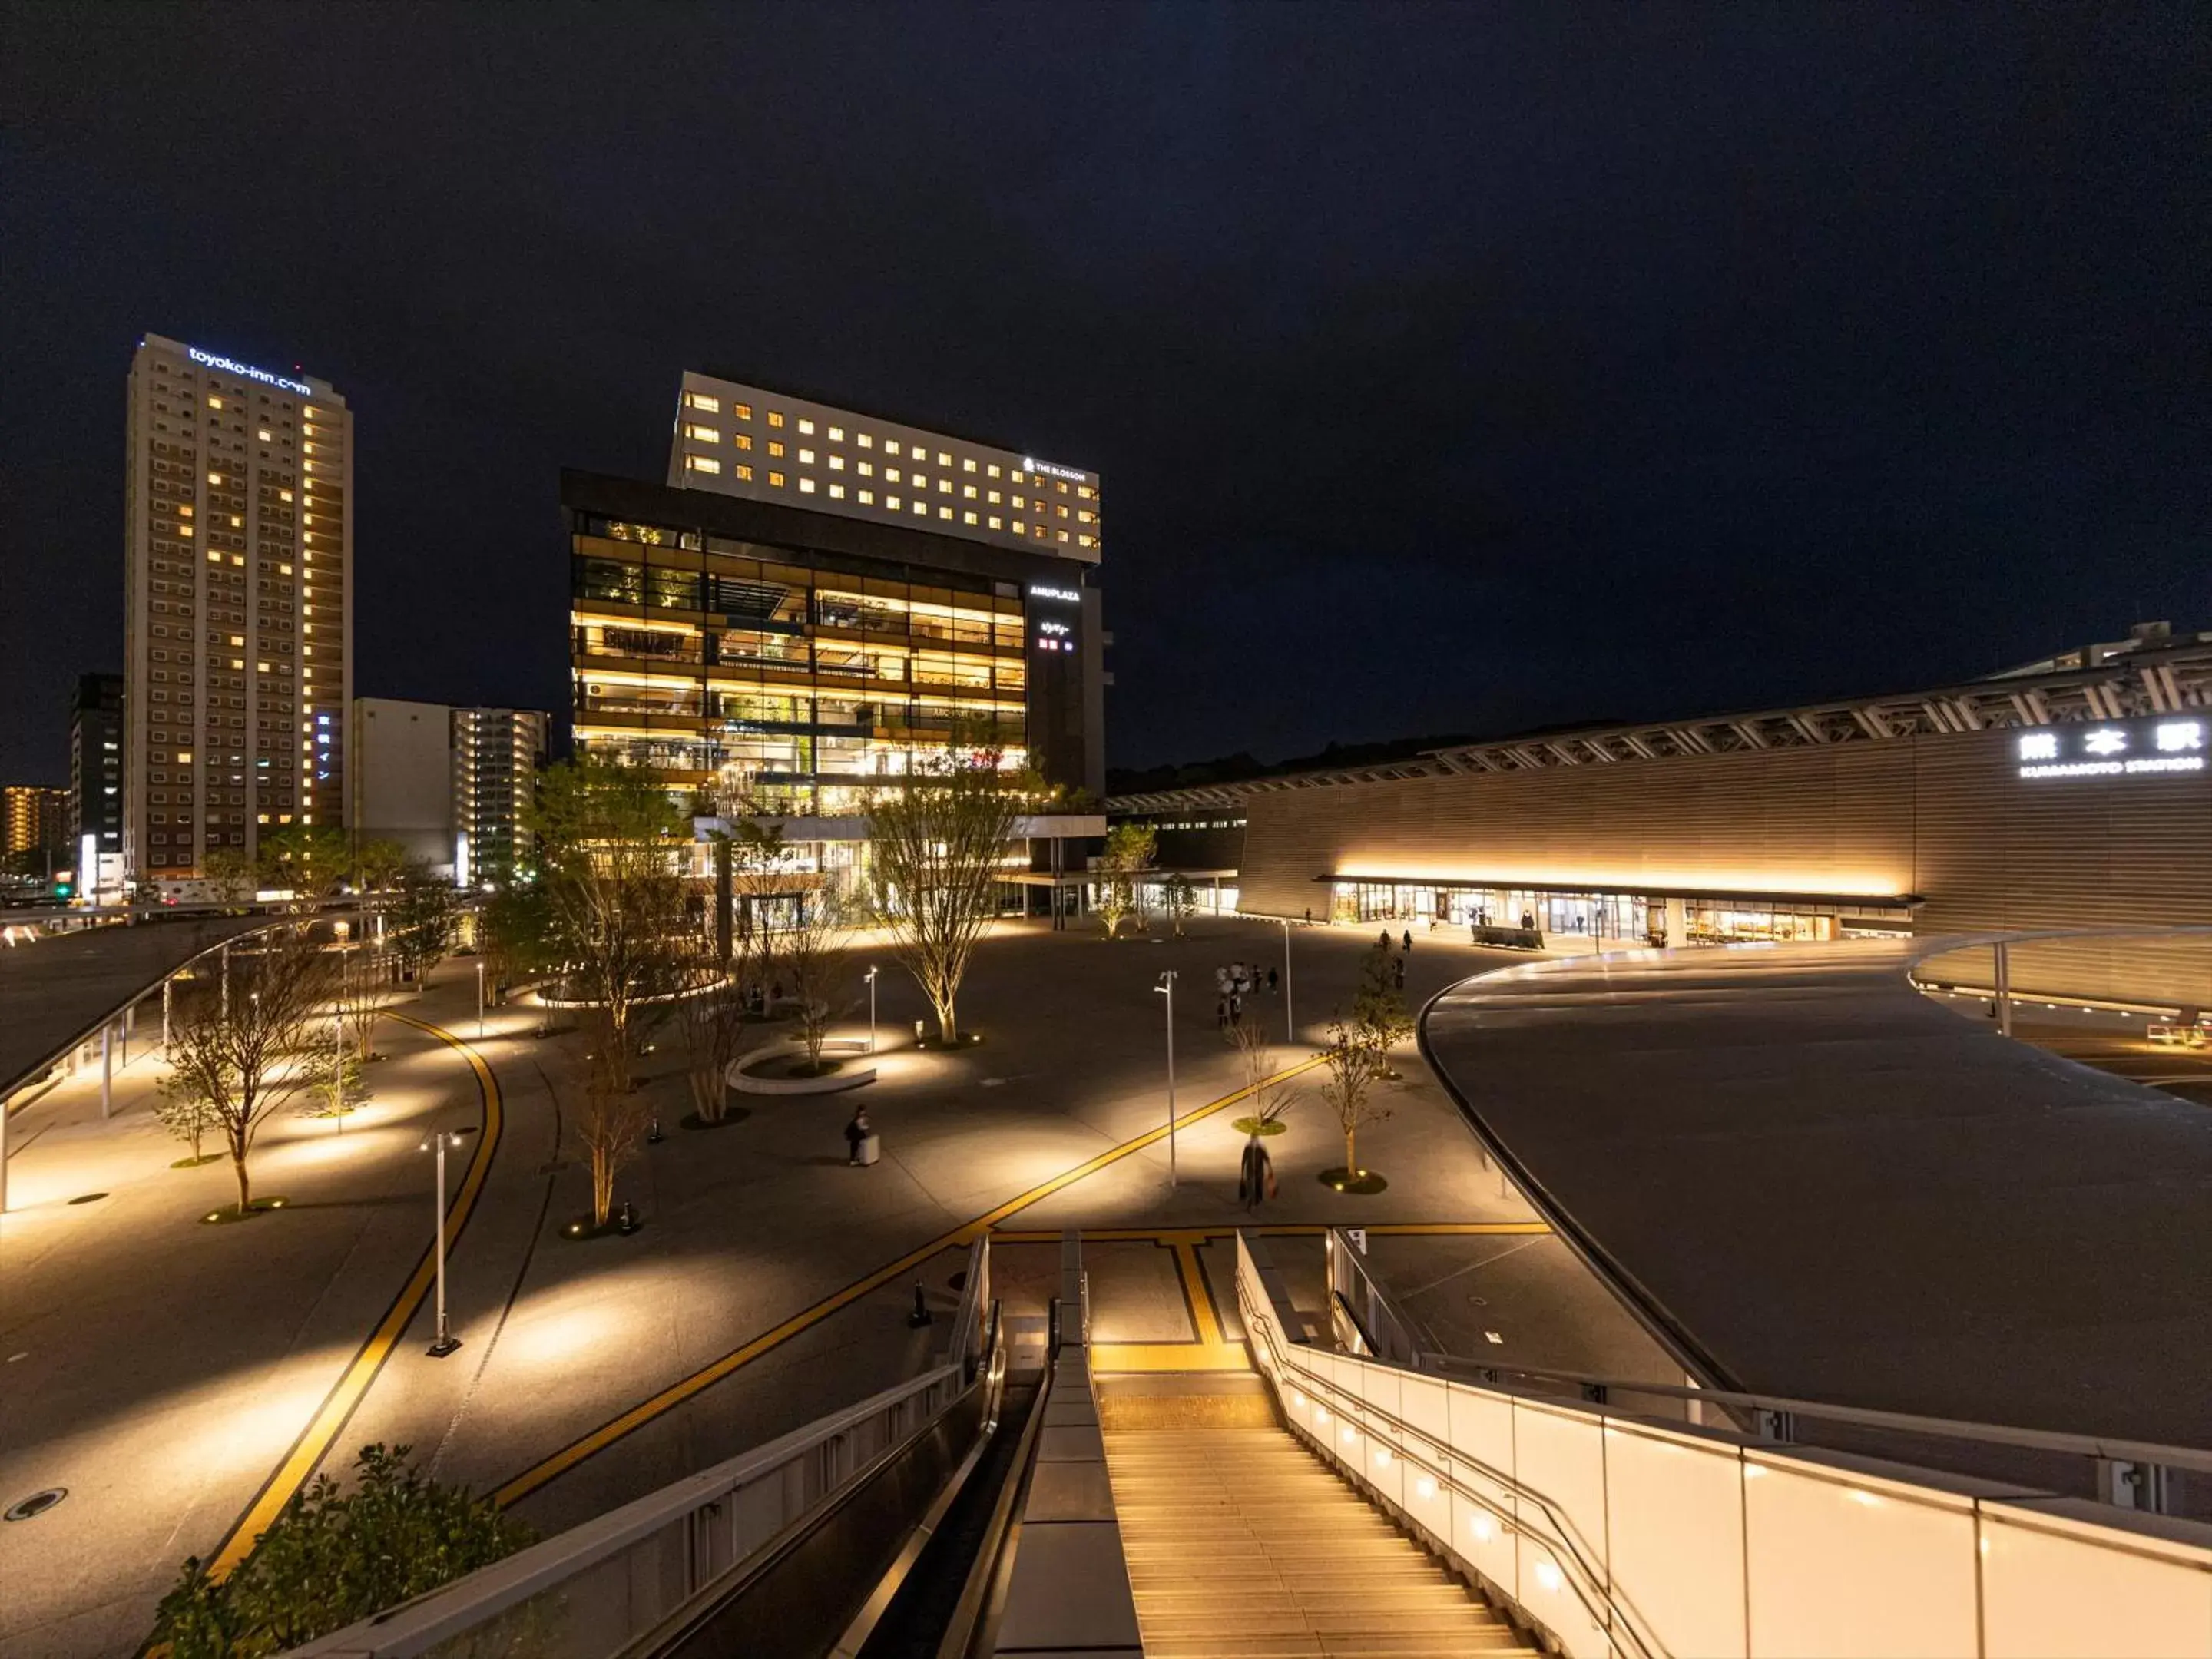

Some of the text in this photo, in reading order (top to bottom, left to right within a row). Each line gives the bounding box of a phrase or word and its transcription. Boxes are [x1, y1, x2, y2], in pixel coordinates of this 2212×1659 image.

[189, 348, 311, 396] toyoko-inn.com
[1036, 463, 1085, 482] THE BLOSSOM
